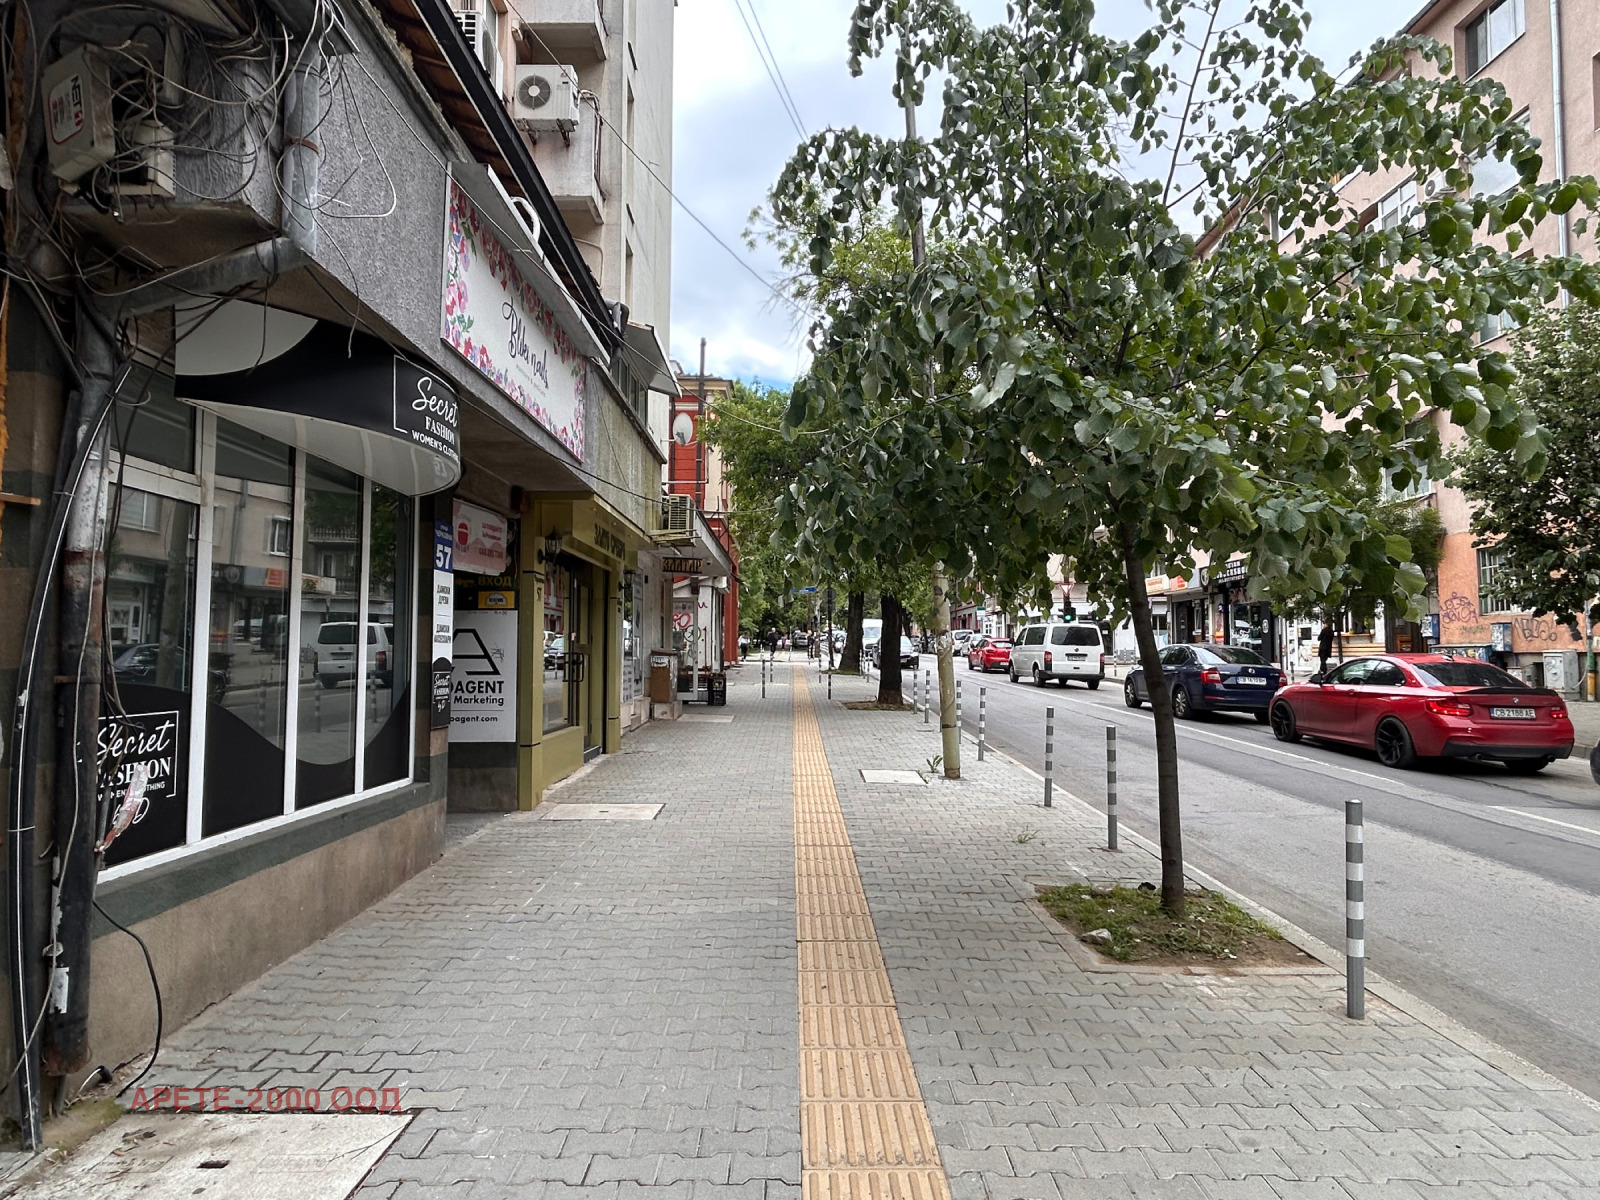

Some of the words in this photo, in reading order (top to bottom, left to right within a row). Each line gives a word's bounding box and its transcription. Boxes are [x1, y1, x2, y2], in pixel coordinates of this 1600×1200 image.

[412, 376, 458, 428] Secret
[411, 429, 443, 451] WOMEN'S
[425, 415, 455, 446] FASHION
[436, 544, 452, 569] 57
[478, 575, 512, 587] ВХОД
[450, 680, 505, 694] AGENT
[453, 694, 505, 707] Marketing
